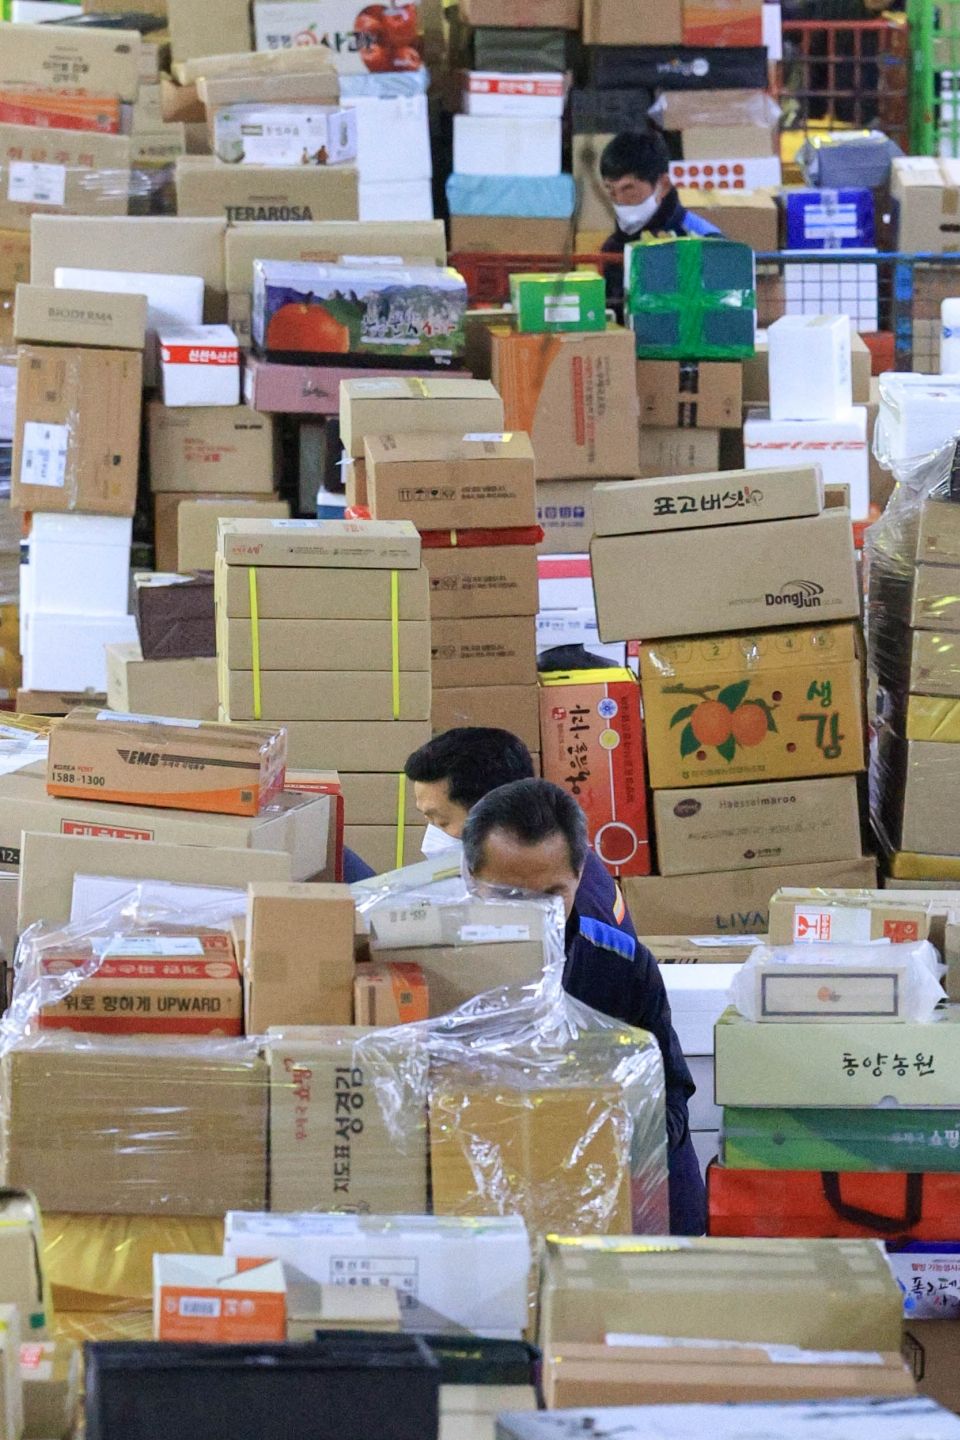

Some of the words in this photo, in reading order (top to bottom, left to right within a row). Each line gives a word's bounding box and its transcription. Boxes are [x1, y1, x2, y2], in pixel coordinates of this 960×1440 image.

[225, 205, 313, 222] TERAROSA
[48, 307, 113, 322] BIODERMA
[653, 490, 745, 516] 표고버섯
[765, 592, 821, 608] DongJun
[798, 680, 844, 759] 생강
[128, 750, 160, 766] EMS
[51, 772, 105, 787] 1588-1300
[64, 995, 95, 1011] 위로
[103, 995, 151, 1011] 향하게
[157, 996, 221, 1011] UPWARD
[842, 1052, 935, 1077] 동양농원
[334, 1067, 364, 1140] 성경김
[334, 1144, 351, 1193] 지도표
